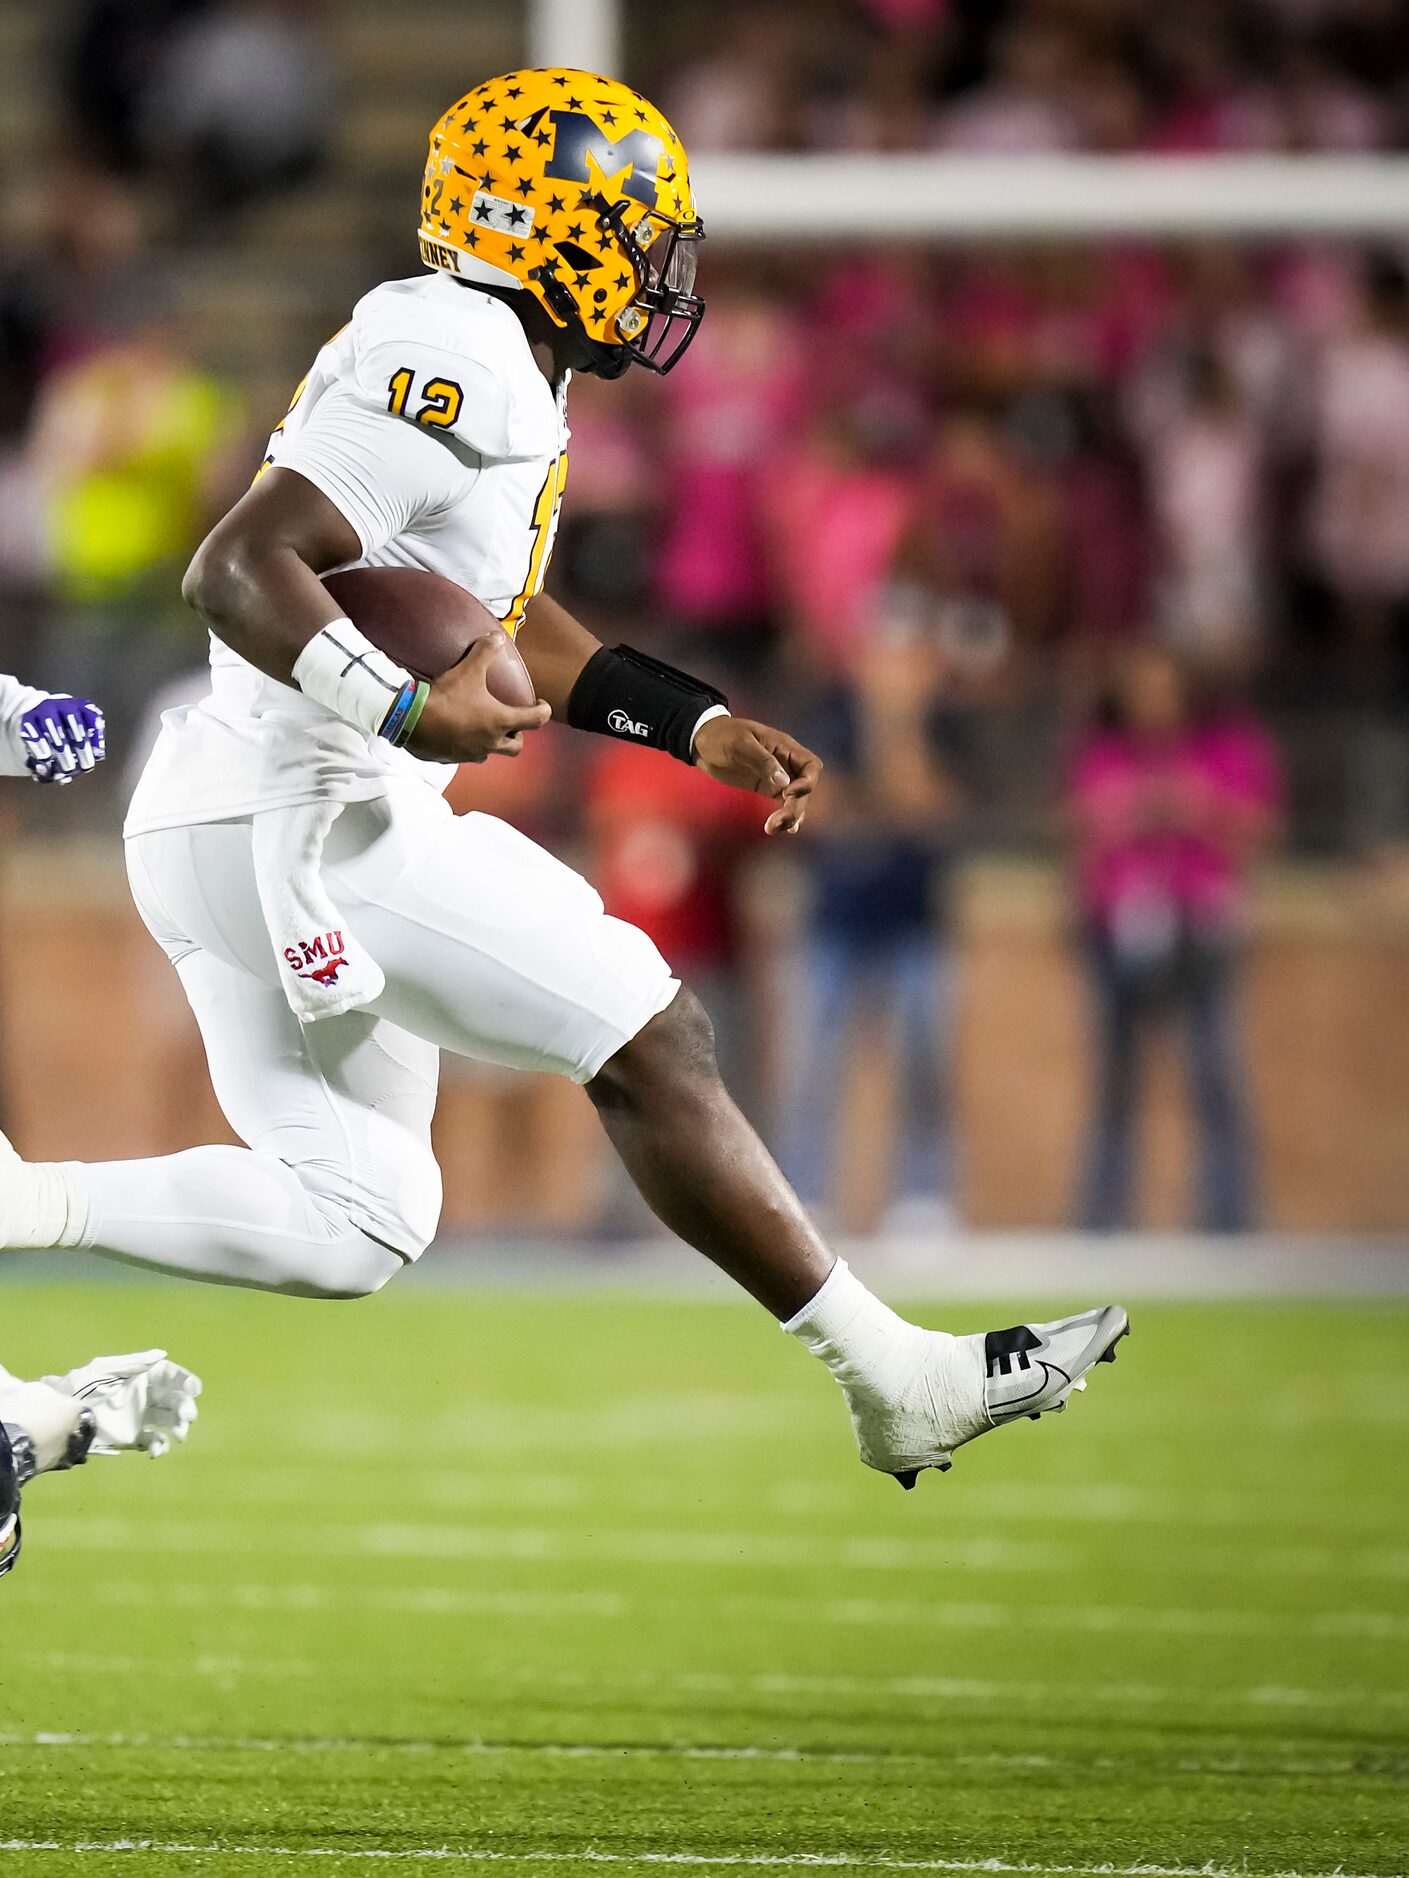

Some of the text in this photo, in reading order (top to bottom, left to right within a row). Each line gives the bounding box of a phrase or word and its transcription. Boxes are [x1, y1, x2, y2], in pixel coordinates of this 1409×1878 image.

[543, 110, 665, 210] M
[388, 367, 464, 428] 12
[608, 710, 649, 738] TAG
[284, 931, 345, 971] SMU
